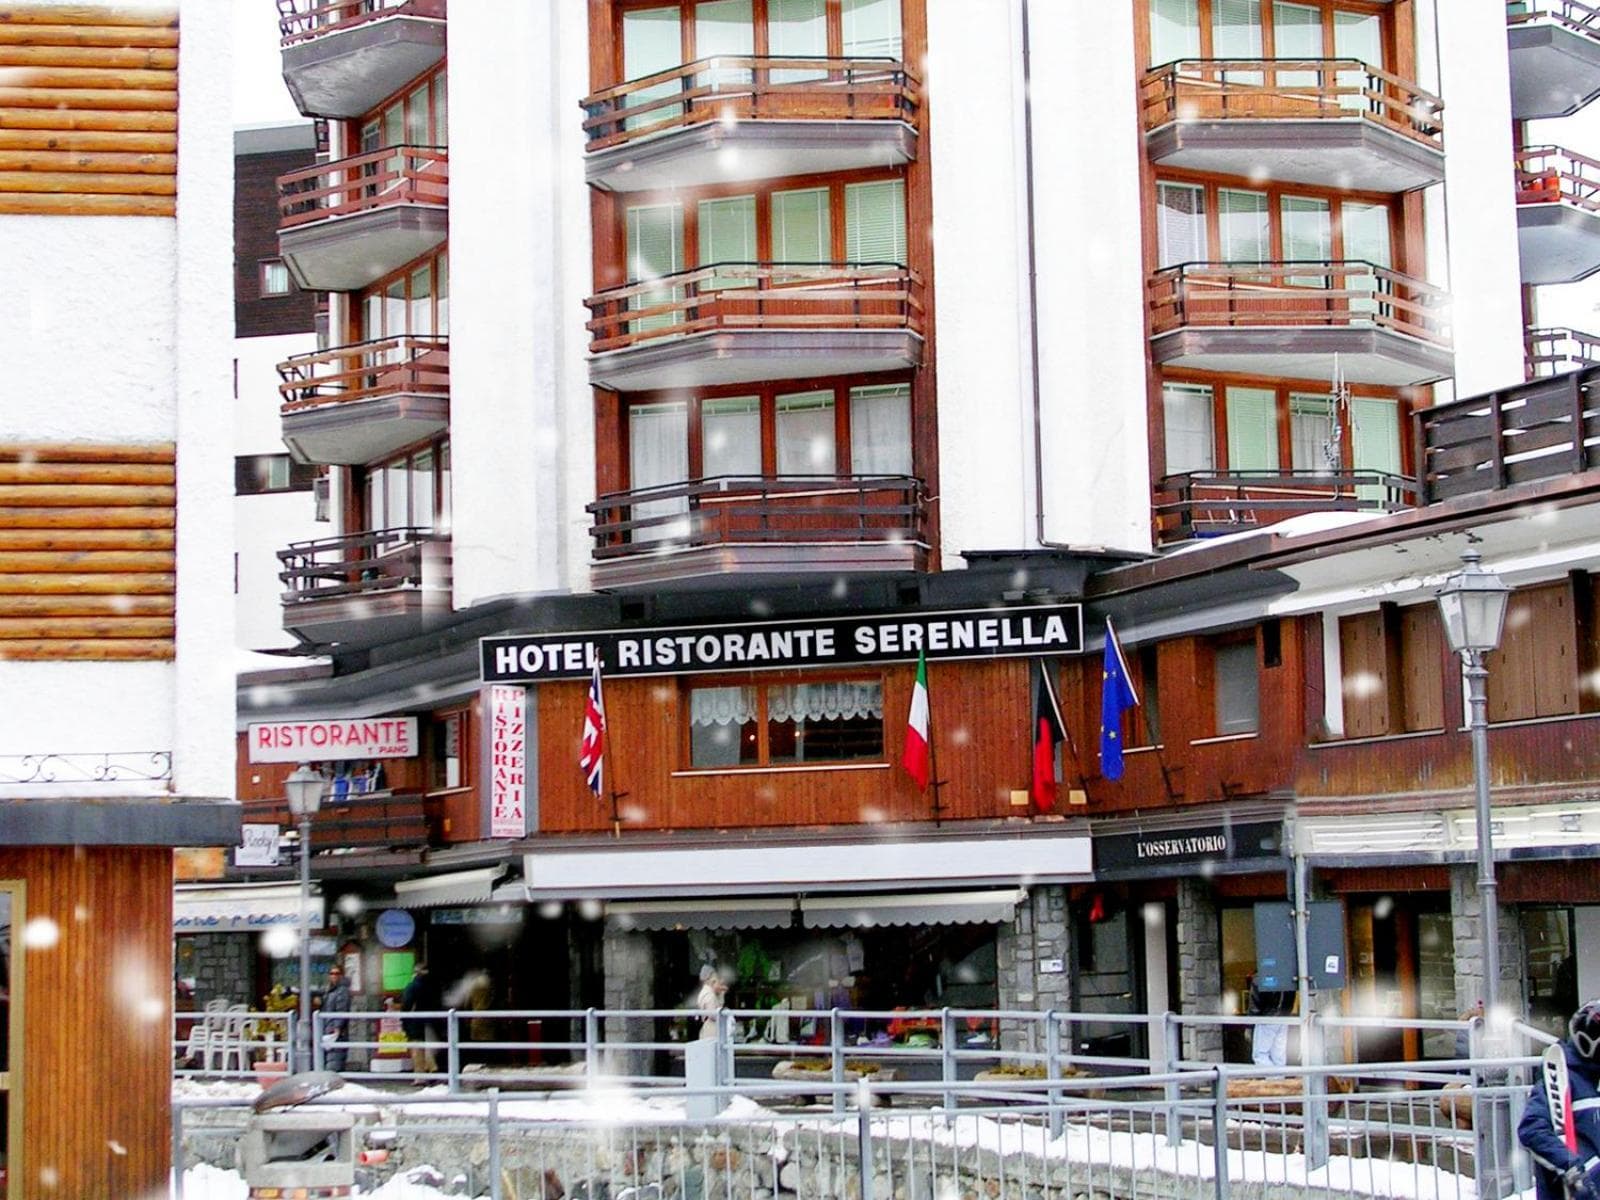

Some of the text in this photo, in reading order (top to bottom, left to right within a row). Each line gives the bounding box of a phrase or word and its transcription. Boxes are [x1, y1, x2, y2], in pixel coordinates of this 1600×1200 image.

[496, 615, 1068, 674] HOTEL RISTORANTE SERENELLA
[258, 721, 408, 748] RISTORANTE
[494, 688, 508, 818] RISTORANTE
[510, 689, 525, 819] PIZZERIA
[1137, 835, 1226, 858] L'OSSERVATORIO
